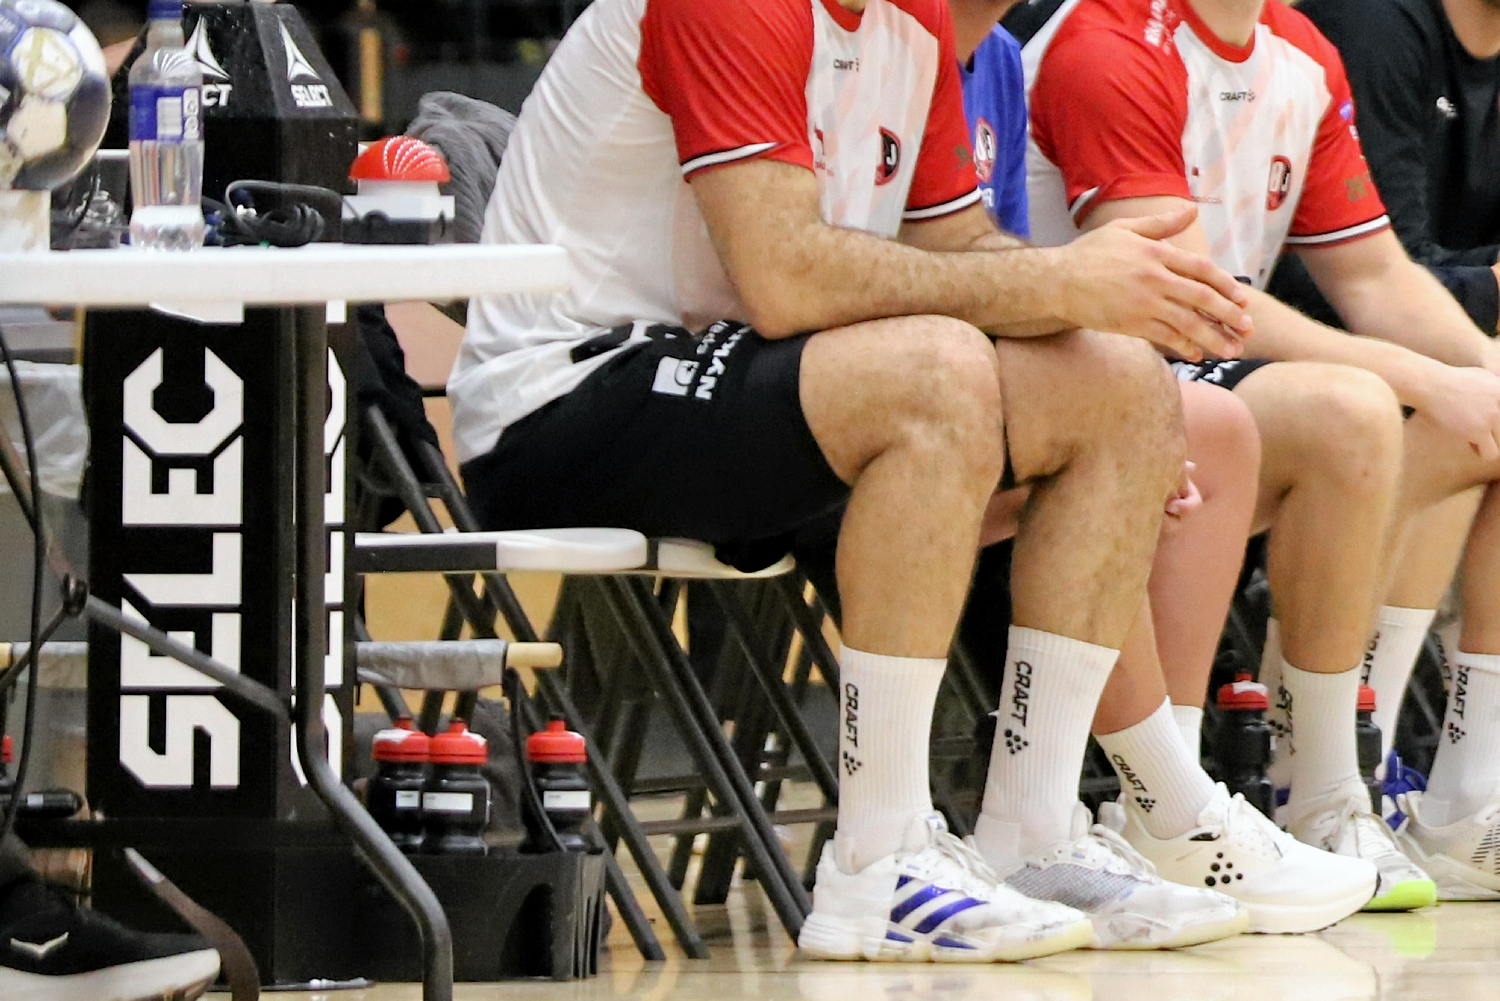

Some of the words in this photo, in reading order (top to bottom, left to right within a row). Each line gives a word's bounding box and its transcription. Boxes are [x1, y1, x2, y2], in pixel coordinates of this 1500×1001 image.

[291, 84, 334, 107] SELECT
[119, 301, 245, 788] SELEC
[845, 683, 859, 748] CRAFT
[1010, 660, 1032, 728] CRAFT
[1112, 754, 1148, 793] CRAFT
